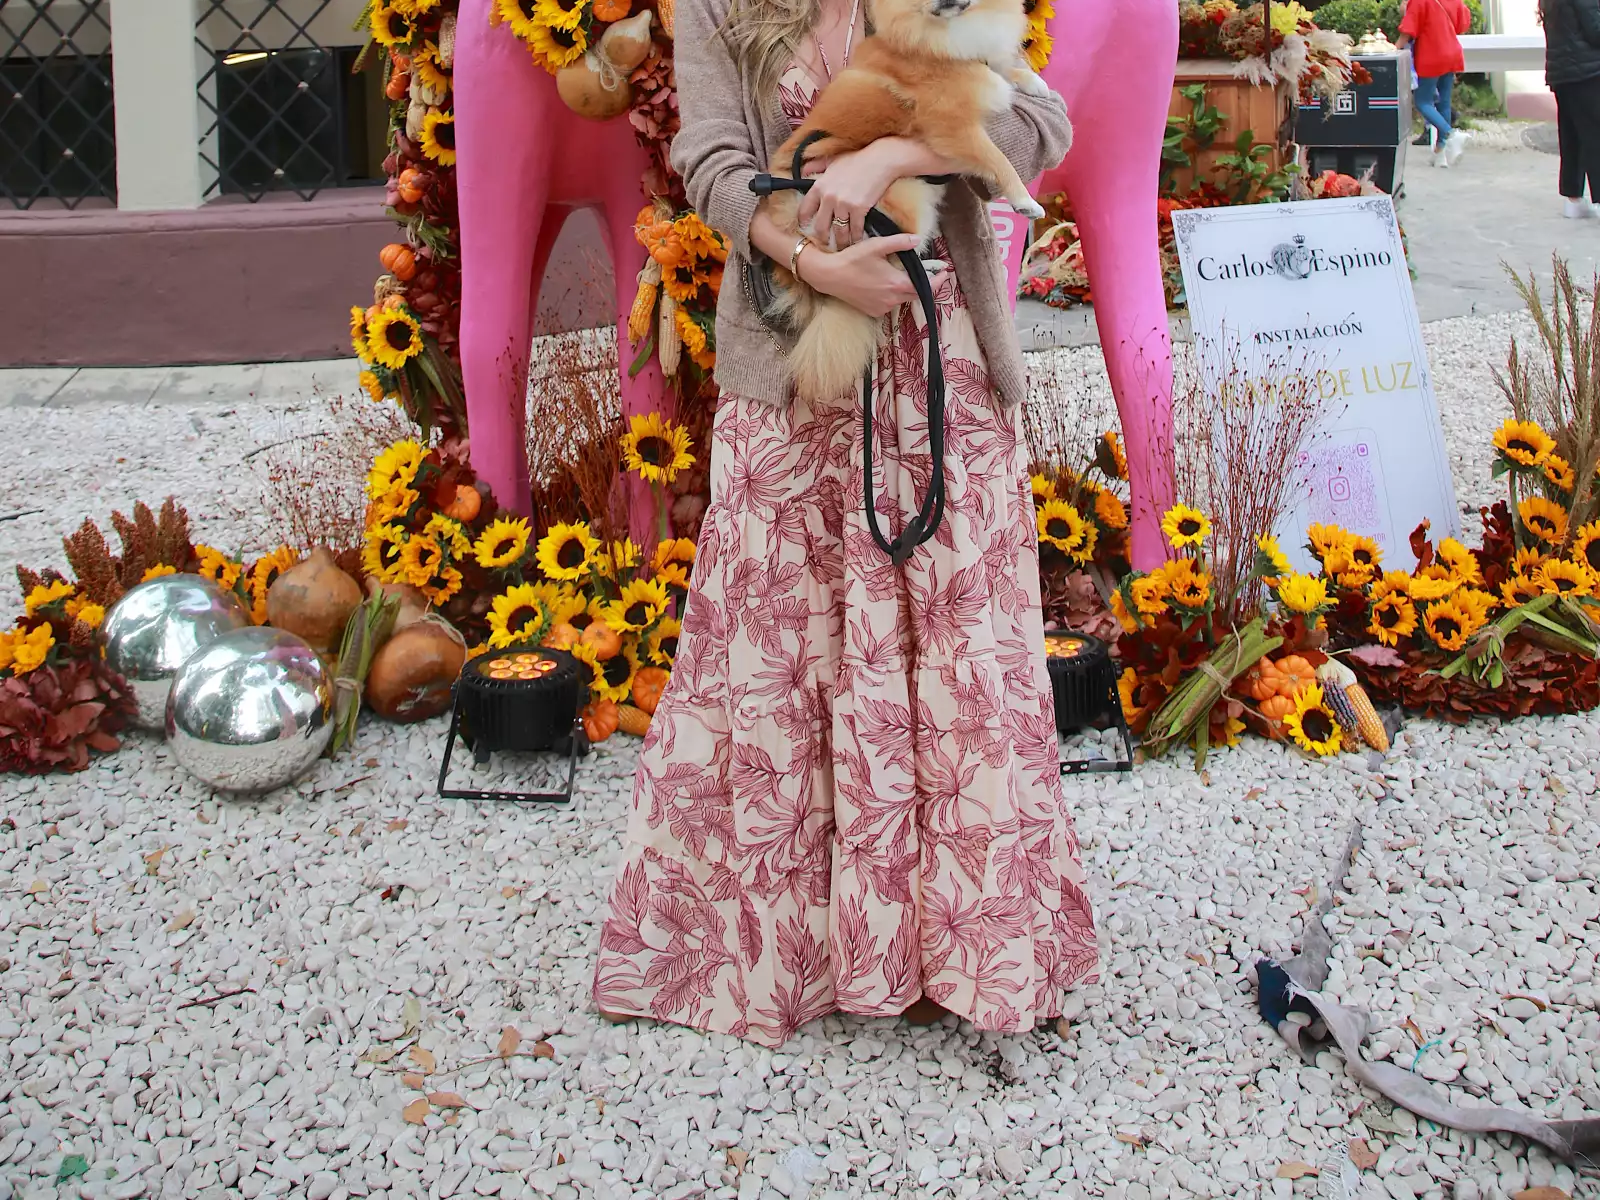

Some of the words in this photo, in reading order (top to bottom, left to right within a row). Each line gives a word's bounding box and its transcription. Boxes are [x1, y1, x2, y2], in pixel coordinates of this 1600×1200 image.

[1197, 253, 1277, 281] Carlos
[1310, 247, 1391, 276] Espino
[1316, 368, 1354, 399] DE
[1361, 361, 1418, 394] LUZ
